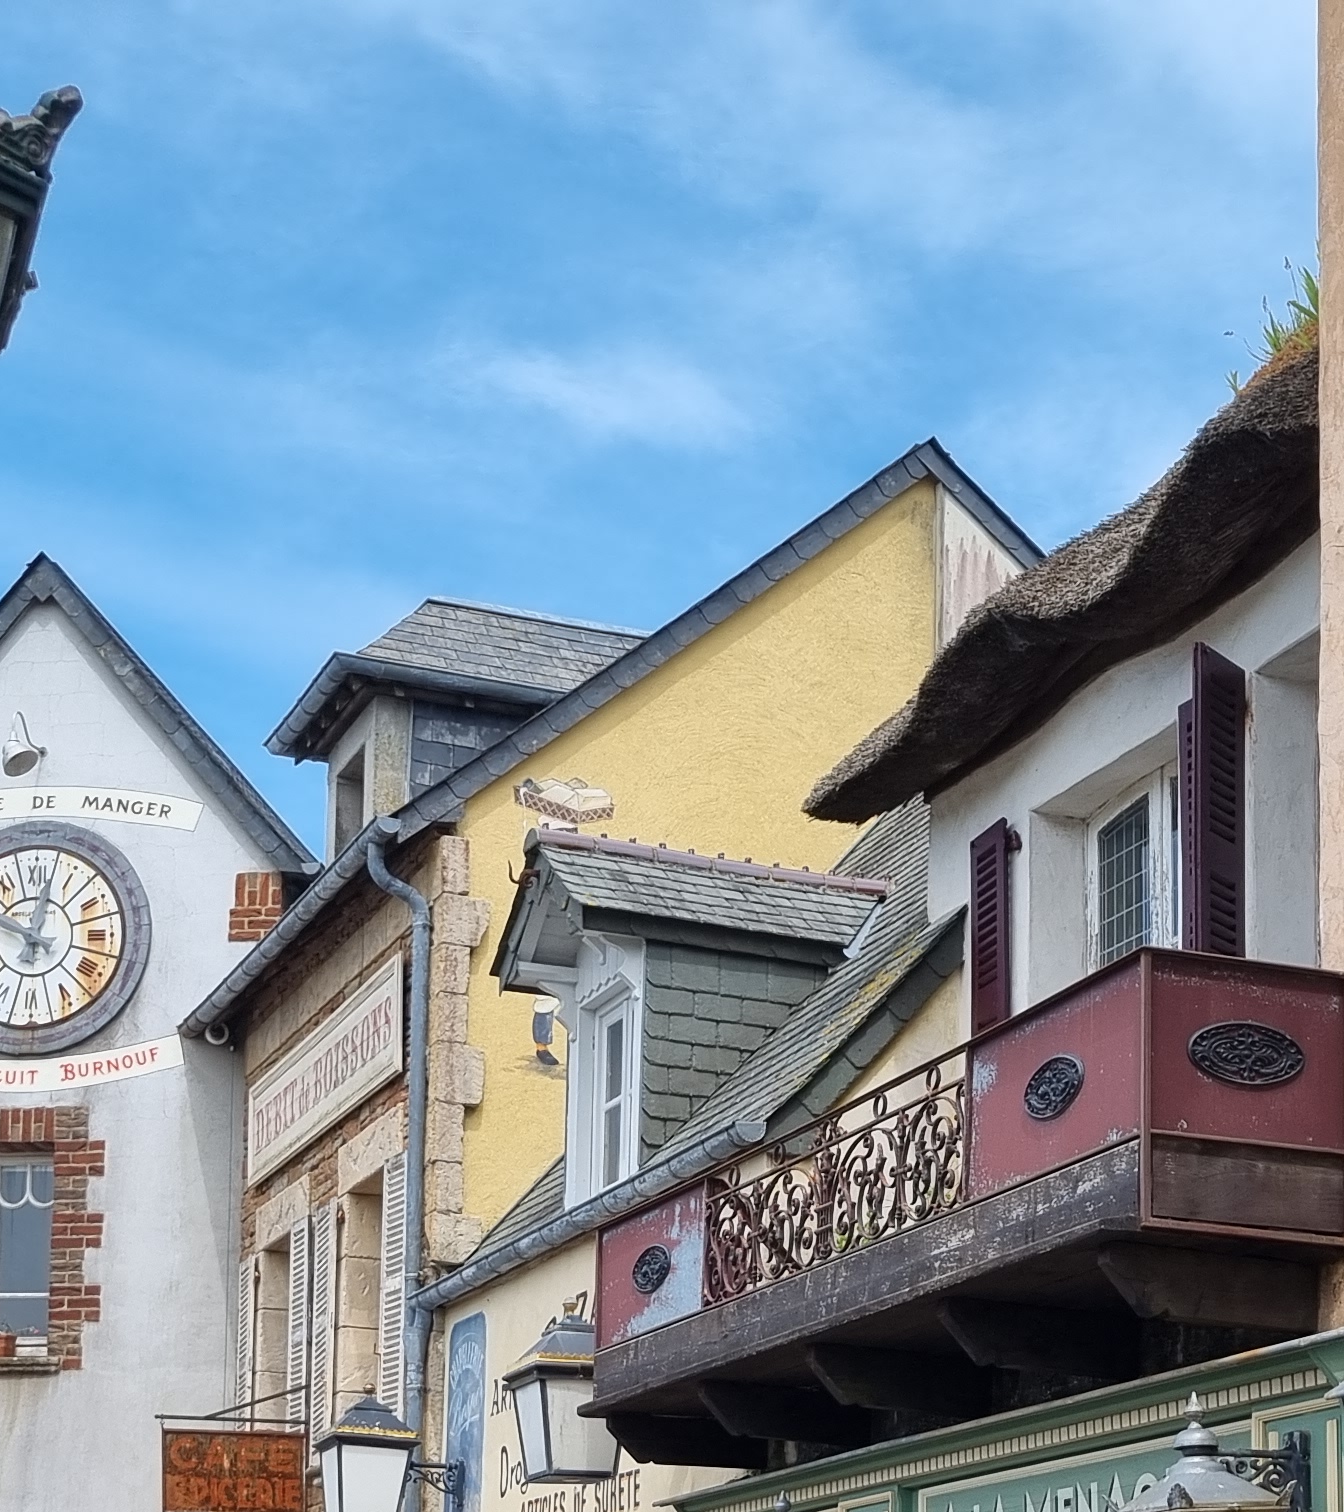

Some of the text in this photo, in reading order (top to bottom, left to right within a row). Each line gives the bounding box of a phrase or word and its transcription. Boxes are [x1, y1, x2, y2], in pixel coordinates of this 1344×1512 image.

[31, 795, 57, 810] DE
[81, 795, 173, 819] MANGER
[313, 995, 392, 1107] BOISSONS
